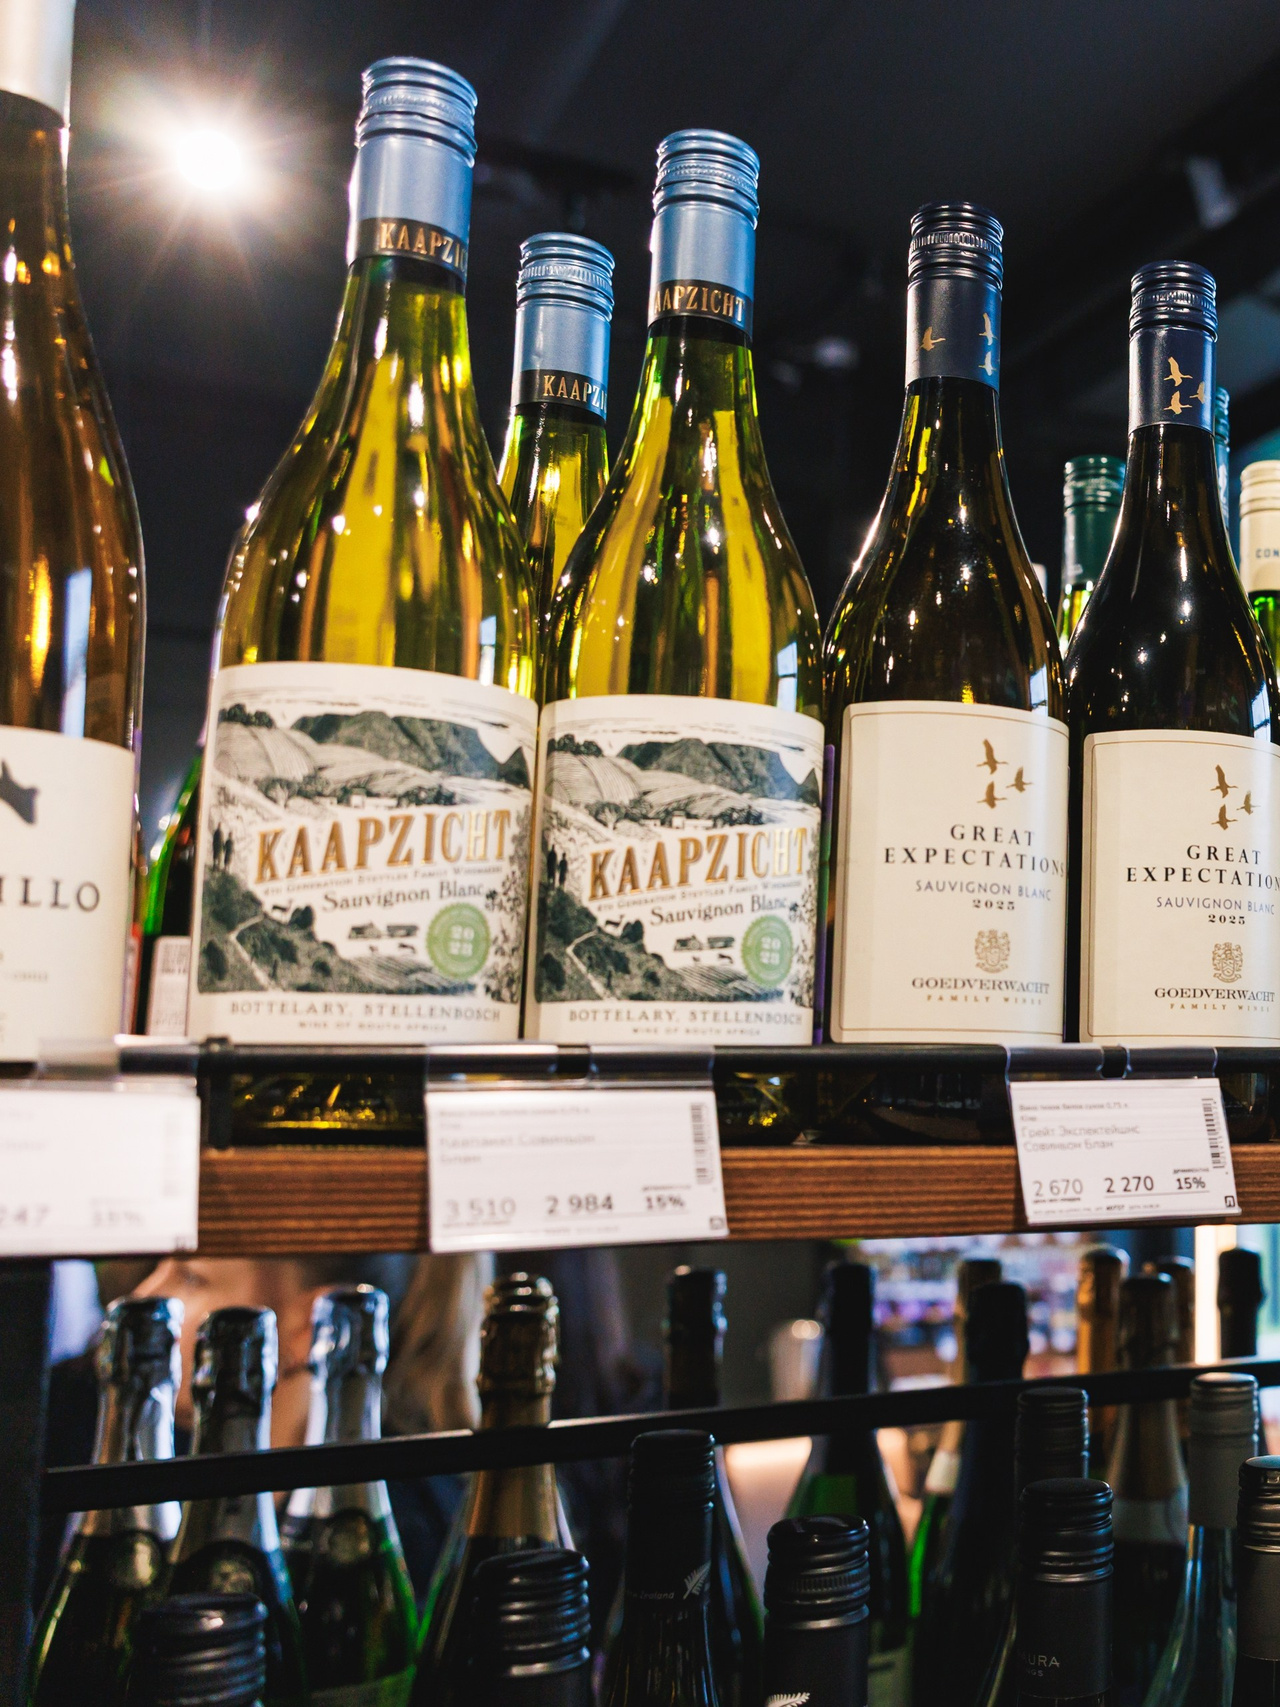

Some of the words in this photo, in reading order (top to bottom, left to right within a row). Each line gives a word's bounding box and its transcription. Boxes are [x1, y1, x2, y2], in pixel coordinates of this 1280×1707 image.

[950, 823, 1035, 847] GREAT
[254, 809, 511, 884] KAAPZICHT
[1186, 844, 1262, 866] GREAT
[588, 827, 808, 901] KAAPZICHT
[884, 847, 1065, 878] EXPECTATIONS
[322, 890, 431, 913] Sauvignon
[439, 880, 486, 900] Blanc
[915, 879, 1012, 897] SAUVIGNON
[1018, 884, 1052, 901] BLANC
[650, 902, 744, 926] Sauvignon
[972, 899, 1016, 912] 2025
[1156, 896, 1243, 912] SAUVIGNON
[1247, 900, 1276, 916] BLANC
[1208, 914, 1246, 925] 2025
[911, 977, 1050, 995] GOEDVERWACHT
[1154, 987, 1276, 1003] GOEDVERWACHT
[926, 994, 991, 1004] FAMILY
[1170, 1003, 1228, 1011] FAMILY
[363, 1003, 501, 1022] STELLENBOSCH
[1033, 1180, 1044, 1197] 2
[1049, 1178, 1084, 1196] 670
[1104, 1177, 1115, 1194] 2
[1120, 1175, 1154, 1193] 270
[1176, 1177, 1206, 1191] 15%
[545, 1194, 560, 1216] 2
[568, 1193, 613, 1214] 984
